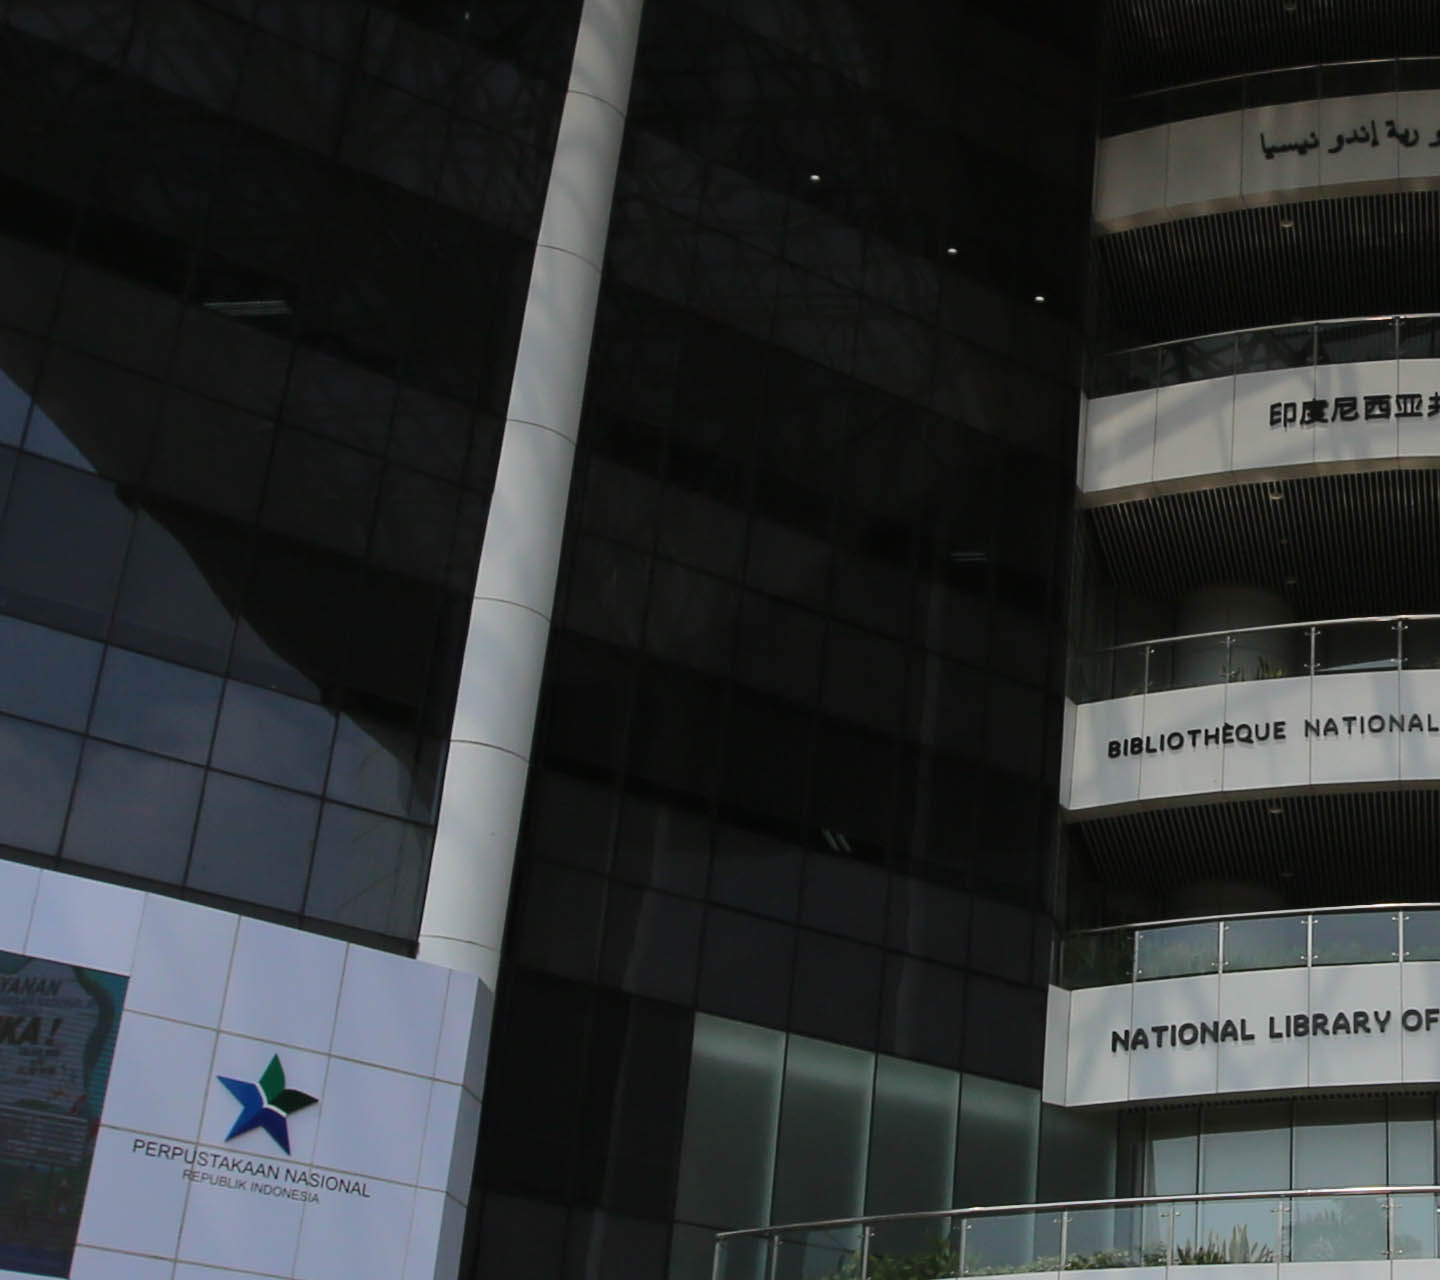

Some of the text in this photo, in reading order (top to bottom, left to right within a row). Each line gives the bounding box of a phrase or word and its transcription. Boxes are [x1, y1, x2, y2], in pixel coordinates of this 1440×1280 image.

[1107, 720, 1287, 759] BIBLIOTHÈQUE
[1111, 1018, 1256, 1053] NATIONAL
[1269, 1010, 1392, 1040] LIBRARY
[1402, 1008, 1440, 1032] OF
[132, 1137, 372, 1199] PERPUSTAKAAN NASIONAL
[181, 1169, 321, 1205] REPUBLIK INDONESIA
